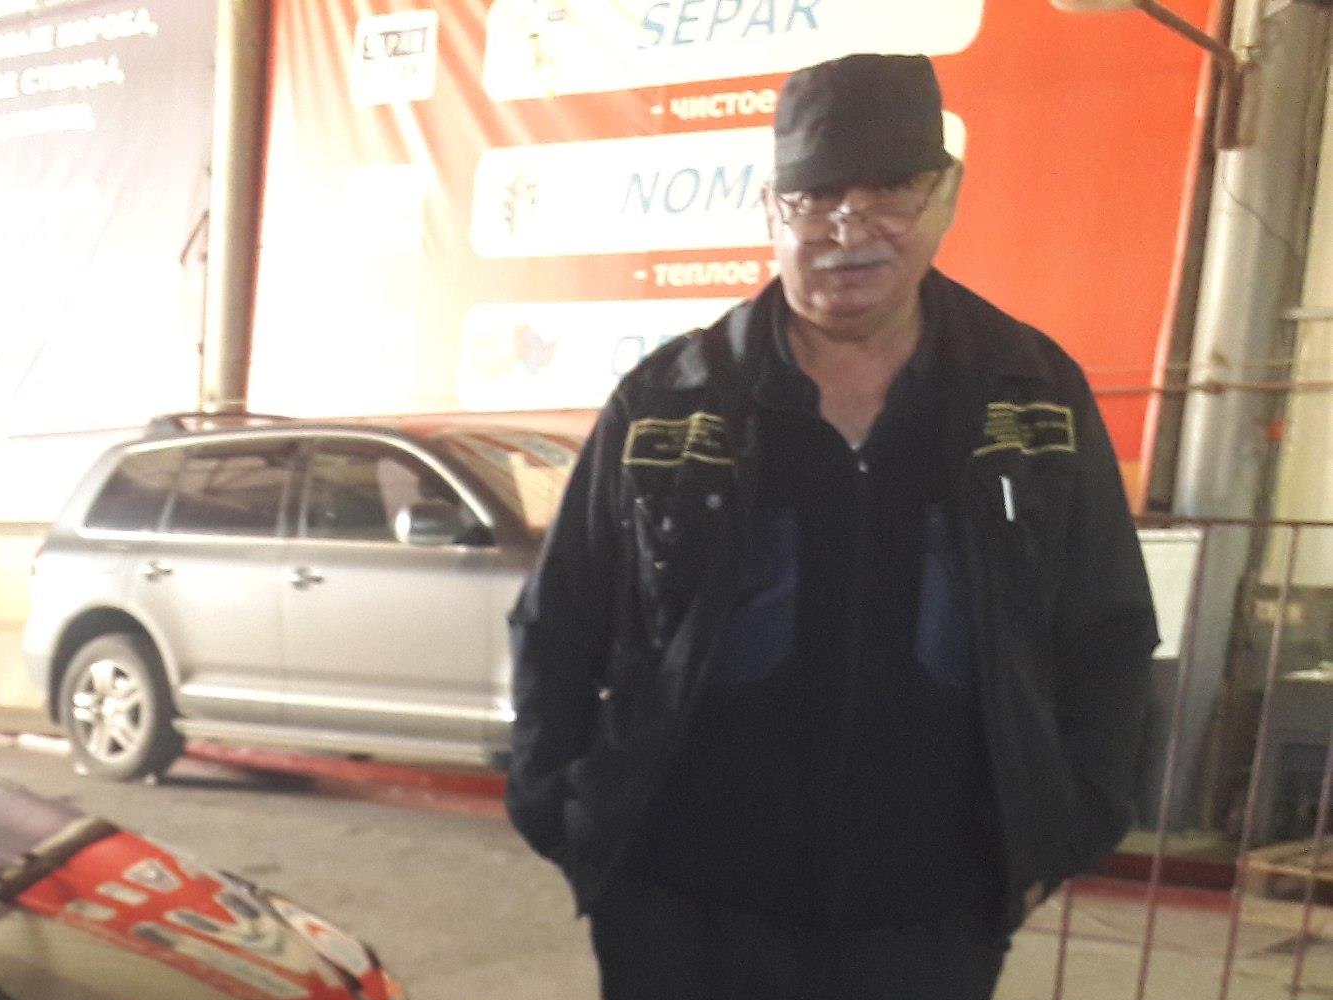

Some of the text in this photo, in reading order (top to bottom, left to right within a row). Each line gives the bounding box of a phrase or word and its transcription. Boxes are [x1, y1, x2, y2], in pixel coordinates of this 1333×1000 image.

[637, 0, 819, 49] SEPAR
[670, 88, 778, 121] чистое
[653, 260, 760, 287] теплое
